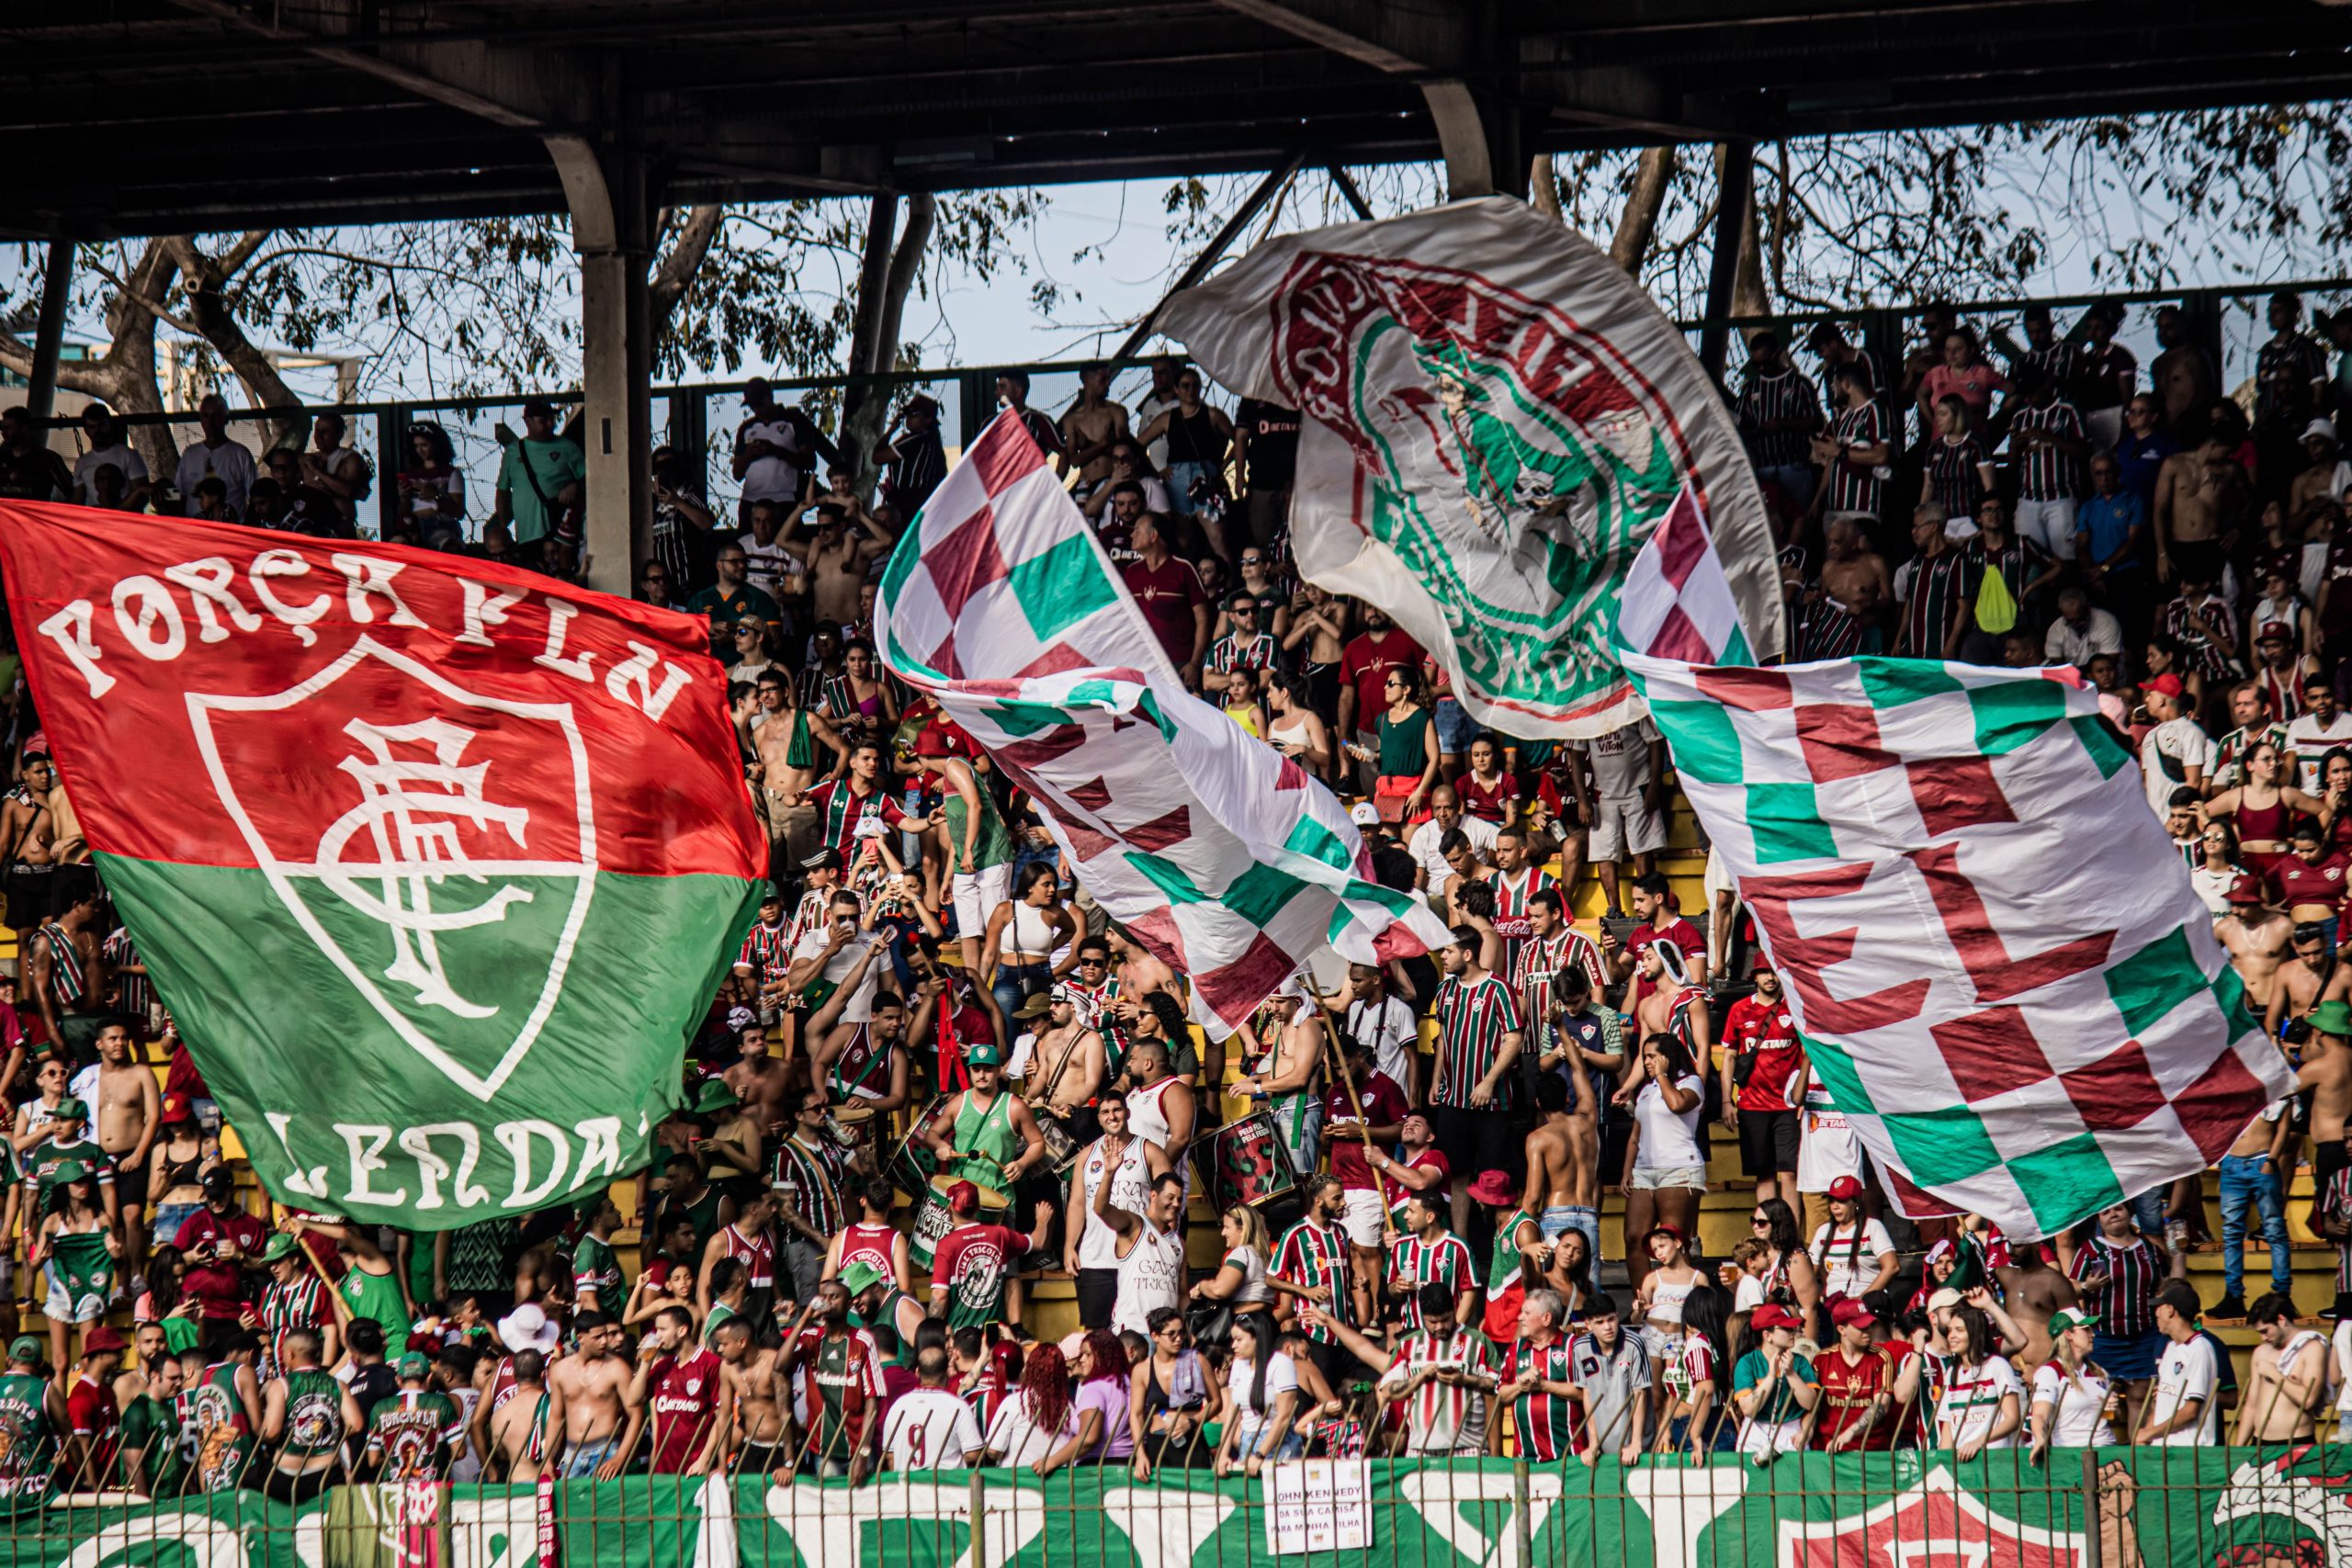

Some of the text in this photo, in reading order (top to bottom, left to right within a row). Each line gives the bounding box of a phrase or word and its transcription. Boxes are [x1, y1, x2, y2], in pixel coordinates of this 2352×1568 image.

[265, 1098, 648, 1209] LENDA
[908, 1422, 926, 1468] 9
[1275, 1491, 1302, 1502] OHN
